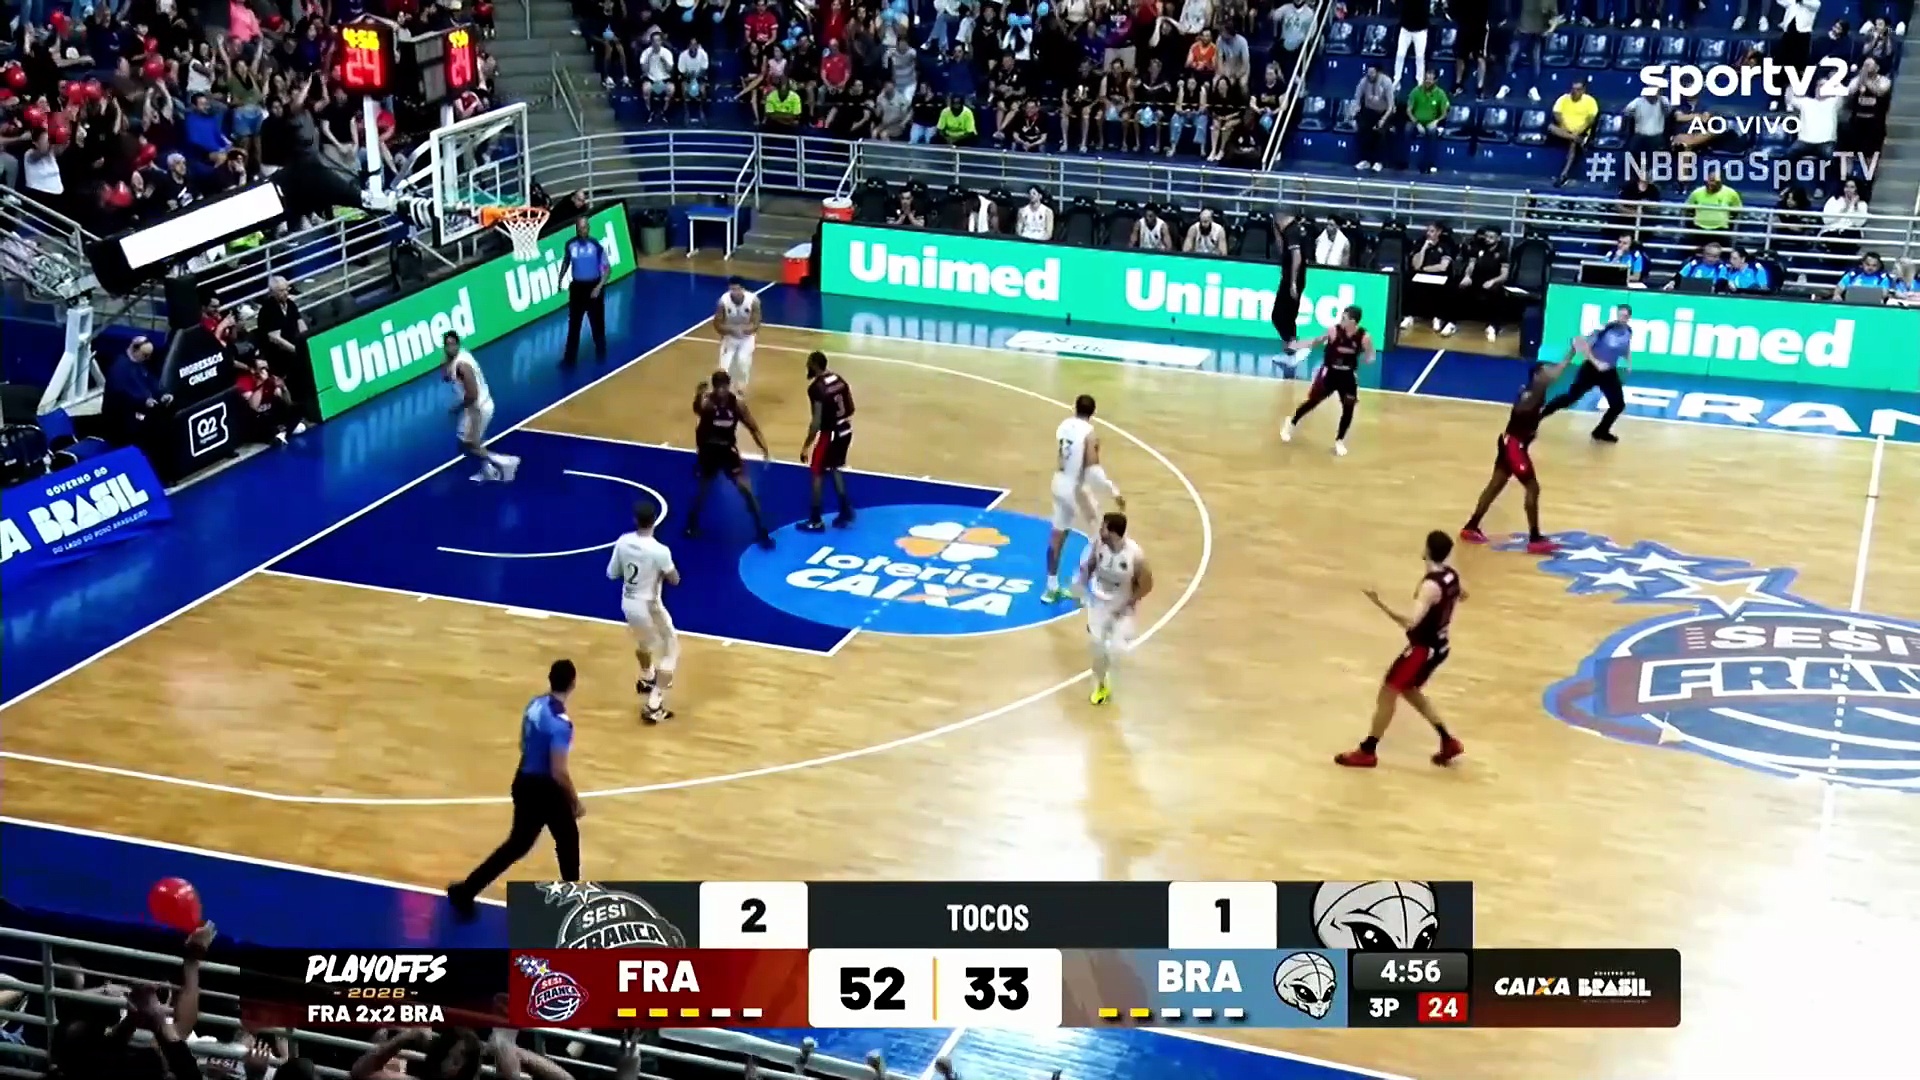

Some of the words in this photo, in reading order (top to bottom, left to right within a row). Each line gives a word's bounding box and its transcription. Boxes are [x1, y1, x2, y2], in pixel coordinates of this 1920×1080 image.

[346, 47, 381, 86] 24
[505, 221, 620, 313] Unid
[849, 240, 1061, 302] Unimed
[330, 286, 475, 393] Unimed
[197, 416, 218, 438] Q2
[46, 473, 91, 497] GOVERNO
[93, 466, 108, 478] DO
[28, 472, 149, 544] BRASIL
[627, 562, 639, 585] 2
[786, 568, 1012, 617] CAIXA
[805, 546, 1034, 594] loterias
[1710, 625, 1911, 656] SESI
